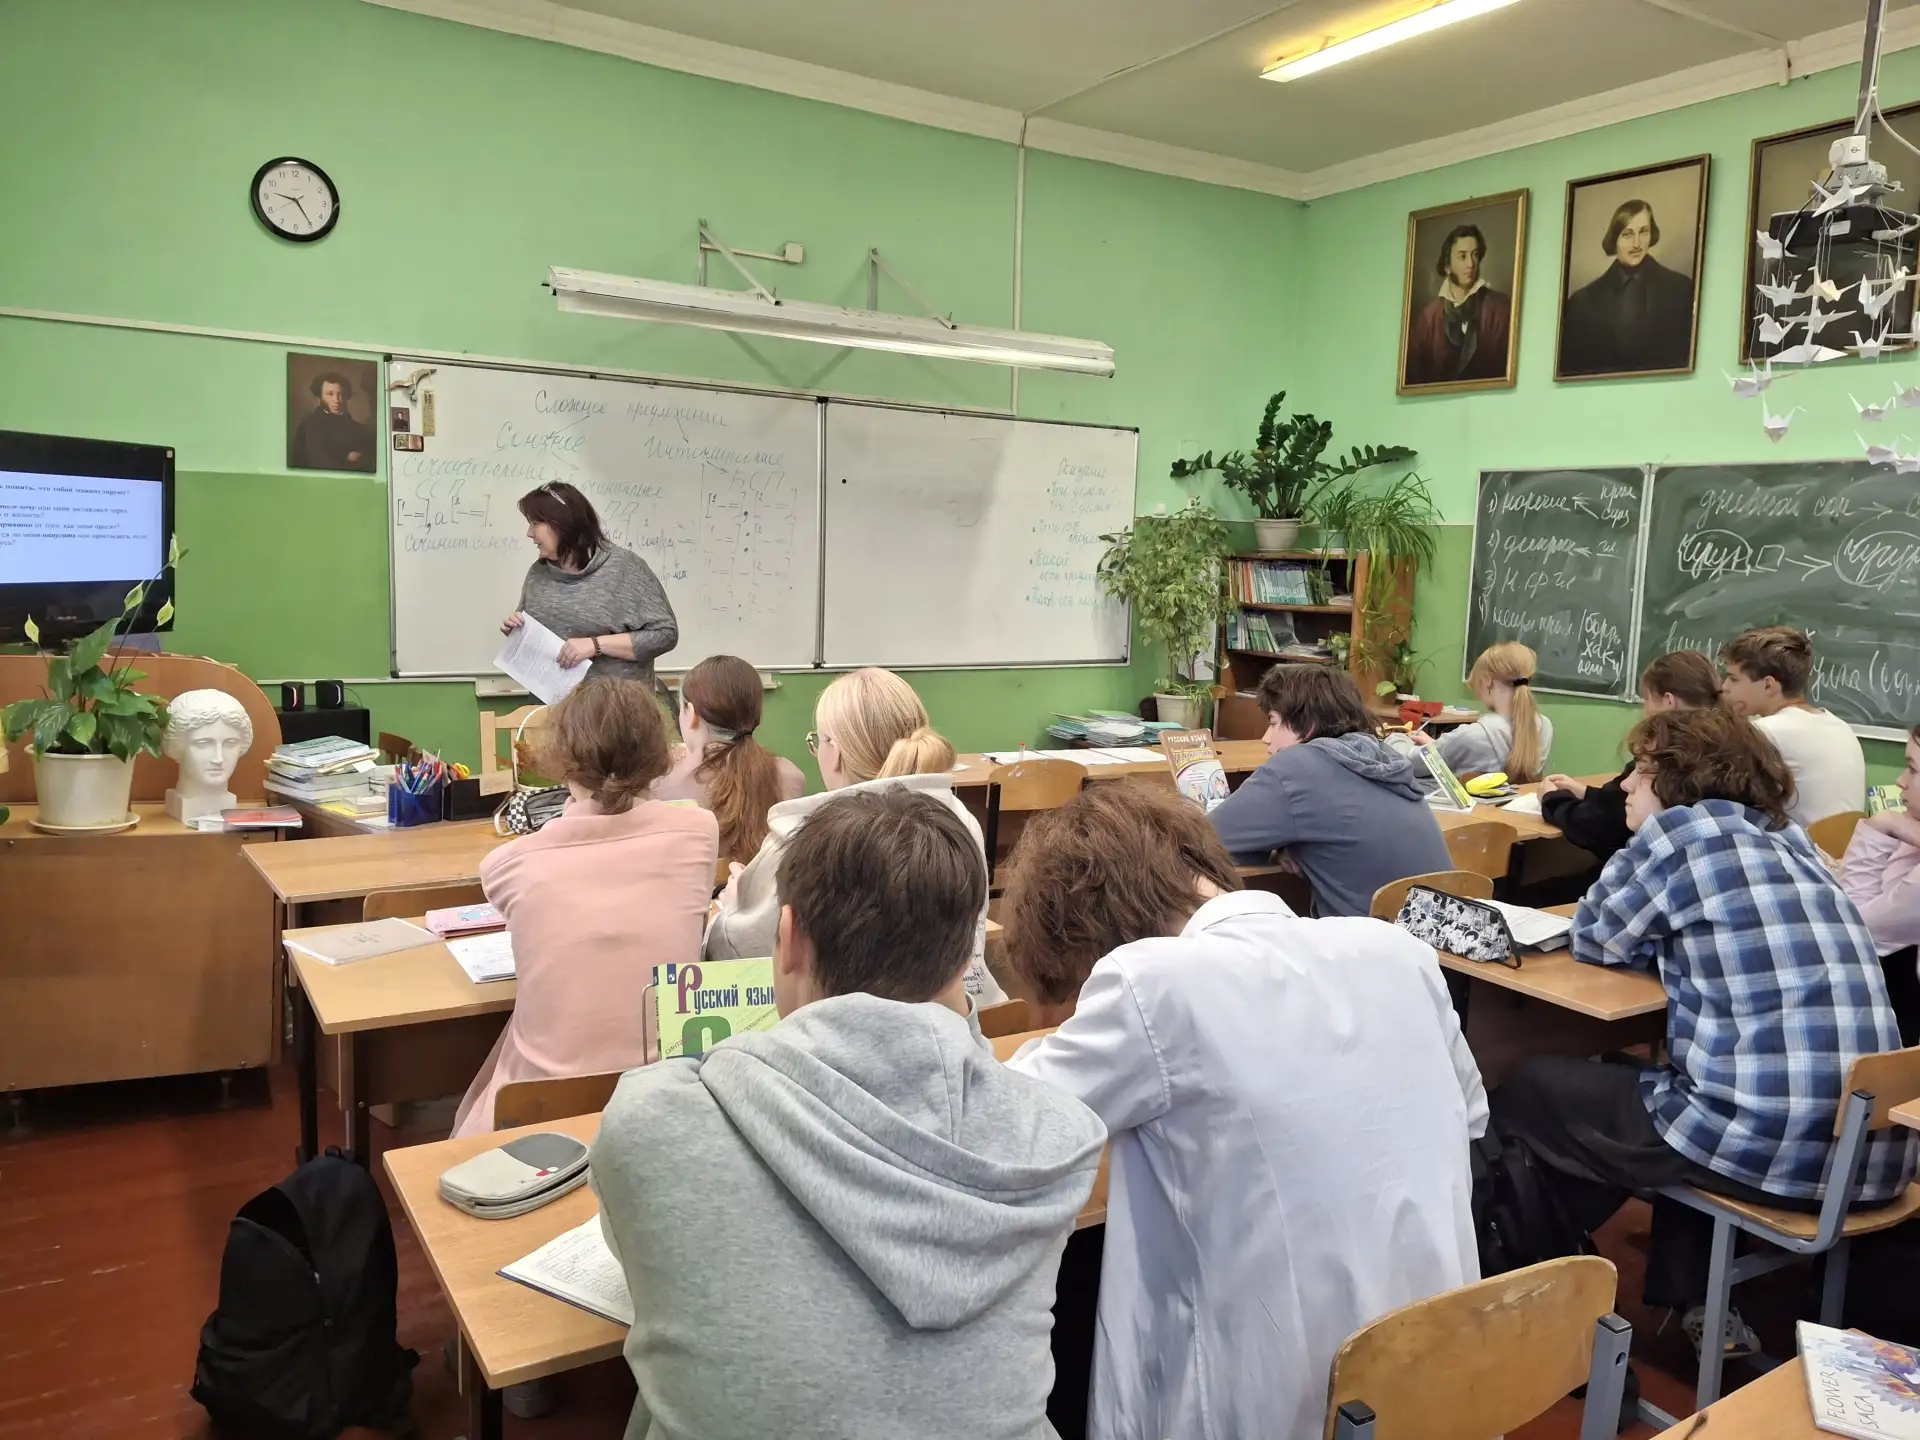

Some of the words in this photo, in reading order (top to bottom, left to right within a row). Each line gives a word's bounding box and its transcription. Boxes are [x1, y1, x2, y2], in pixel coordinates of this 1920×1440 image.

[278, 171, 286, 179] 11
[291, 170, 300, 178] 12
[268, 179, 277, 188] 10
[317, 186, 323, 194] 2
[263, 192, 269, 200] 9
[321, 200, 327, 208] 3
[268, 206, 273, 214] 8
[280, 217, 285, 225] 7
[293, 223, 299, 231] 6
[675, 964, 739, 1014] Русский
[1820, 1371, 1846, 1420] FLOWER
